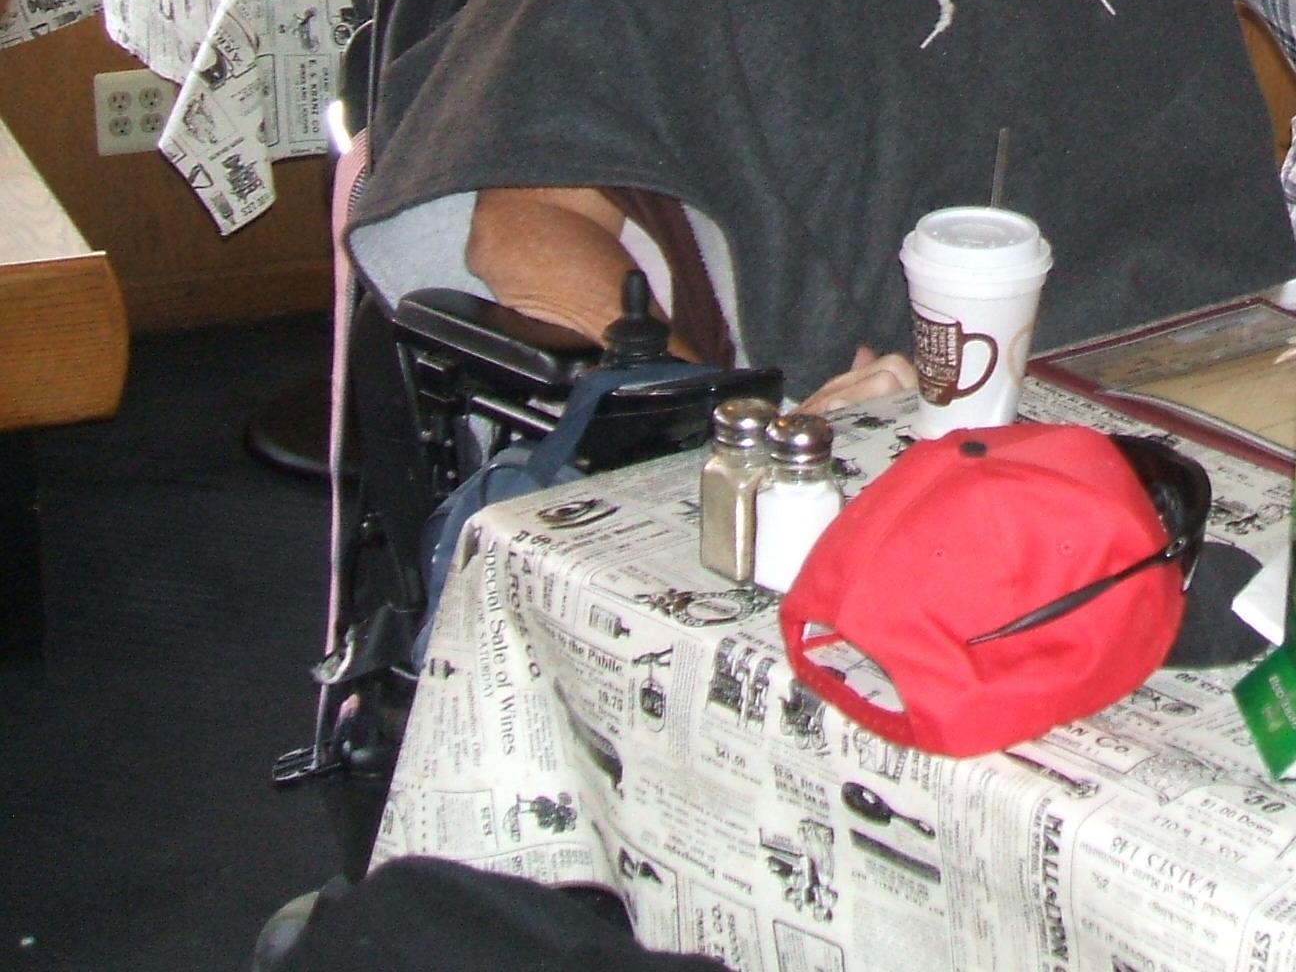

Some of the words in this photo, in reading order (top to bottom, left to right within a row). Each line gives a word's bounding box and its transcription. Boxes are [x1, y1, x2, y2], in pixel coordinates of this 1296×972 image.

[489, 618, 508, 665] Sale
[495, 669, 512, 691] of
[498, 692, 519, 756] Wines
